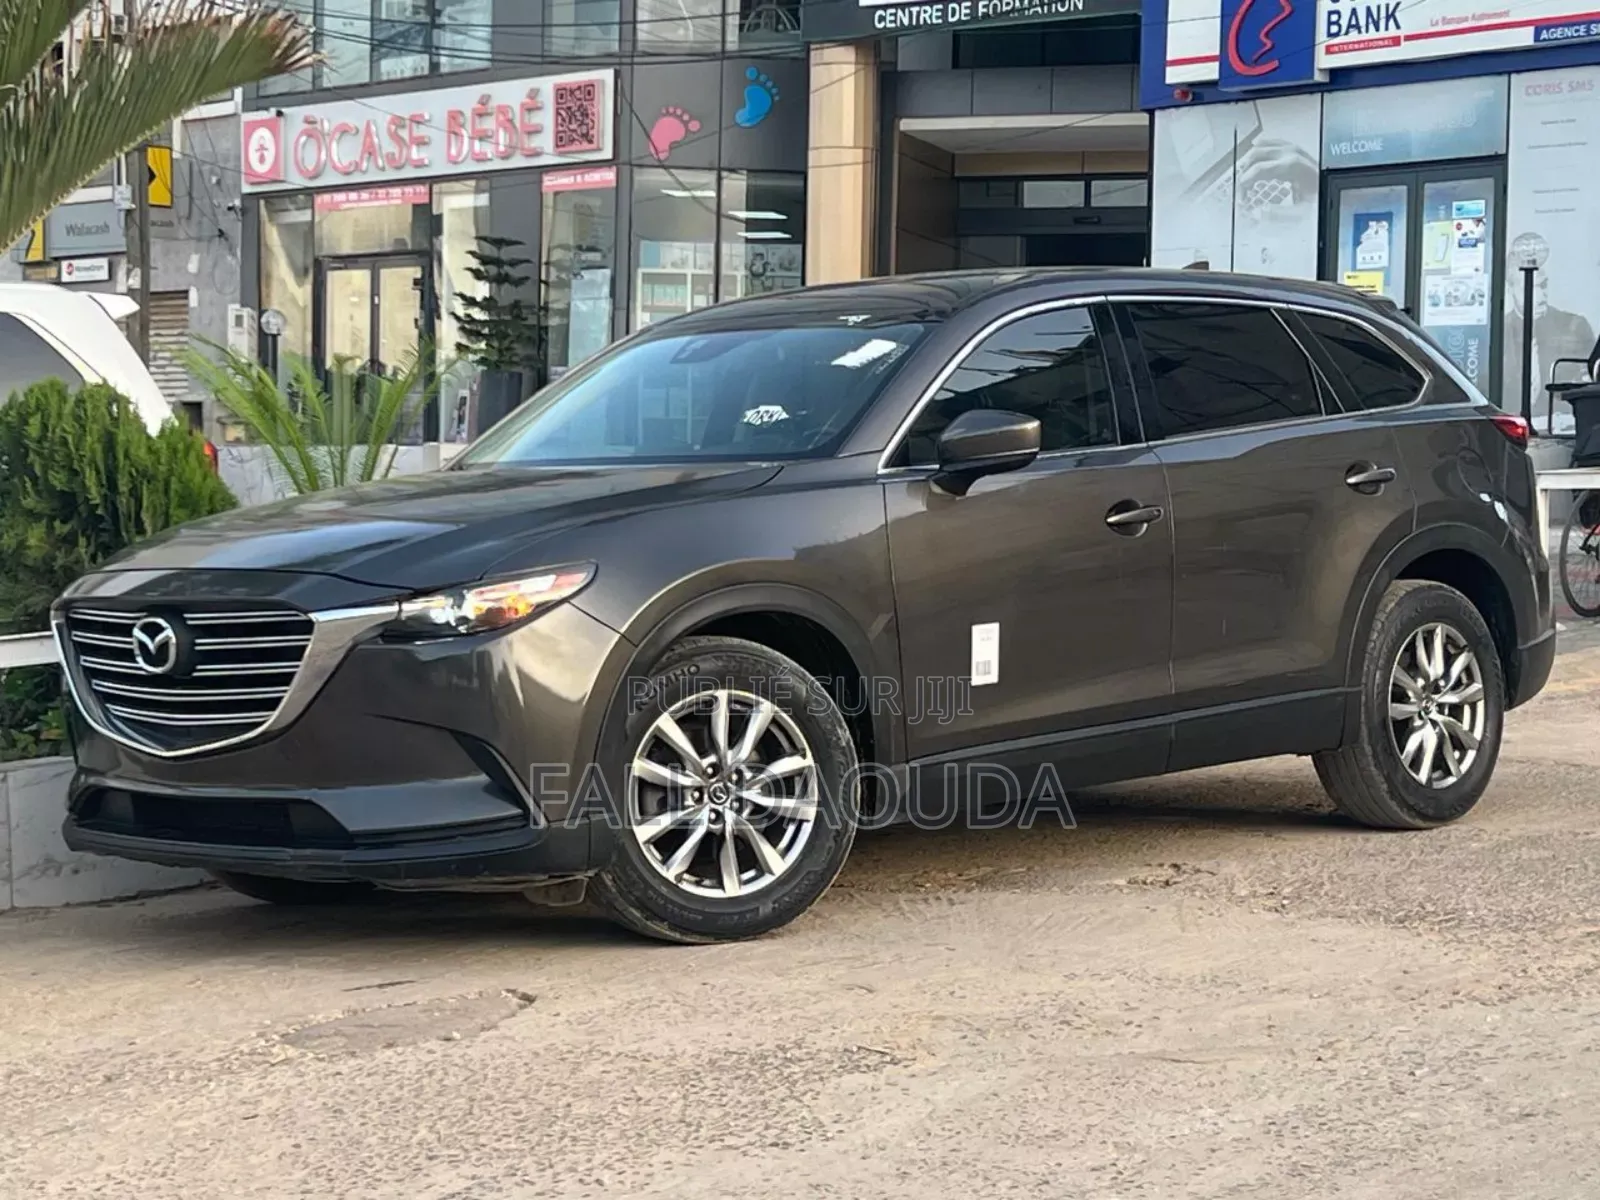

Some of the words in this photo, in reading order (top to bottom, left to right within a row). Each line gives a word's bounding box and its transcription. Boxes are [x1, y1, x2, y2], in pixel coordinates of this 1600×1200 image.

[874, 4, 944, 29] CENTRE
[948, 5, 972, 23] DE
[1326, 1, 1402, 38] BANK
[1539, 24, 1588, 41] AGENCE
[1328, 38, 1394, 53] INTERNATIONAL
[1567, 79, 1594, 93] SMS
[446, 87, 544, 165] BÉBÉ
[1329, 138, 1384, 157] WELCOME
